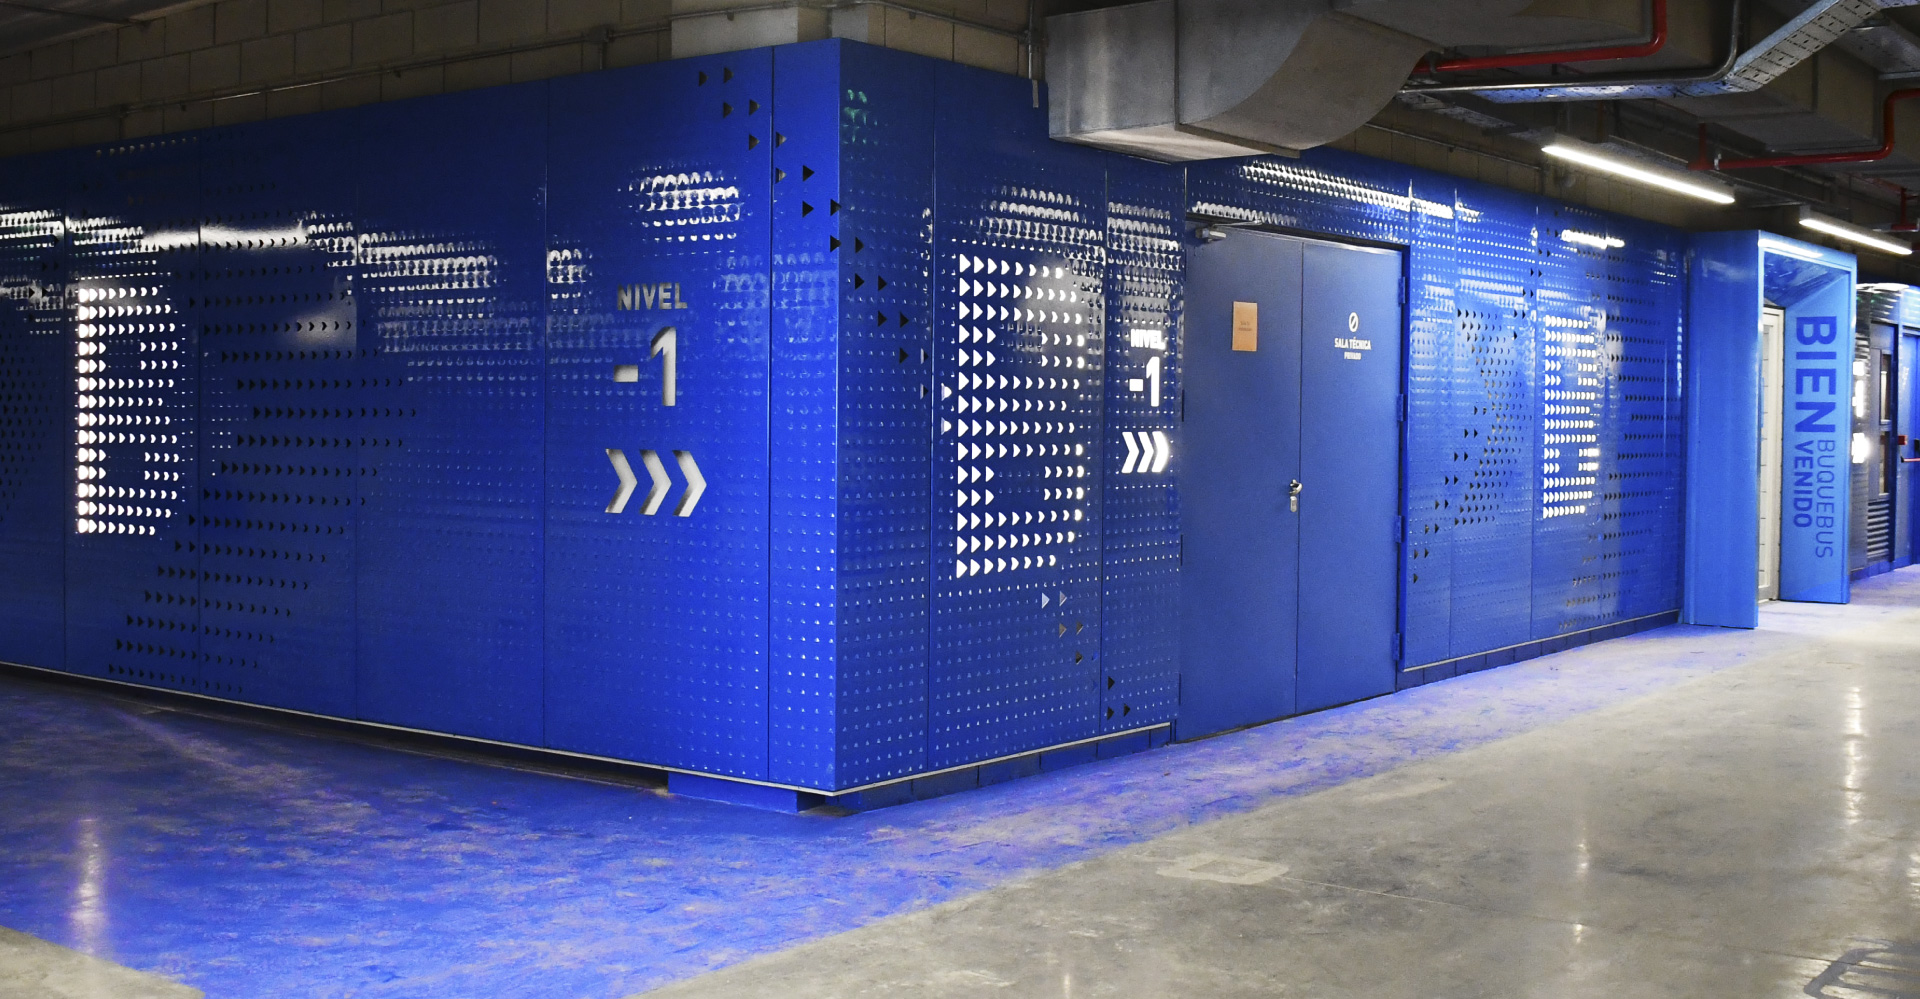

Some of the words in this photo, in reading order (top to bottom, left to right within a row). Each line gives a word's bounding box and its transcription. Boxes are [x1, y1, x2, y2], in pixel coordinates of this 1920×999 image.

[617, 282, 688, 310] NIVEL
[613, 326, 676, 406] -1
[1130, 329, 1166, 350] NIVEL
[1334, 337, 1349, 349] SALA
[1349, 336, 1372, 350] TÉCNICA
[1129, 356, 1160, 407] -1
[1795, 316, 1837, 433] BIEN
[1793, 440, 1814, 528] VENIDO
[1815, 440, 1835, 558] BUQUEBUS
